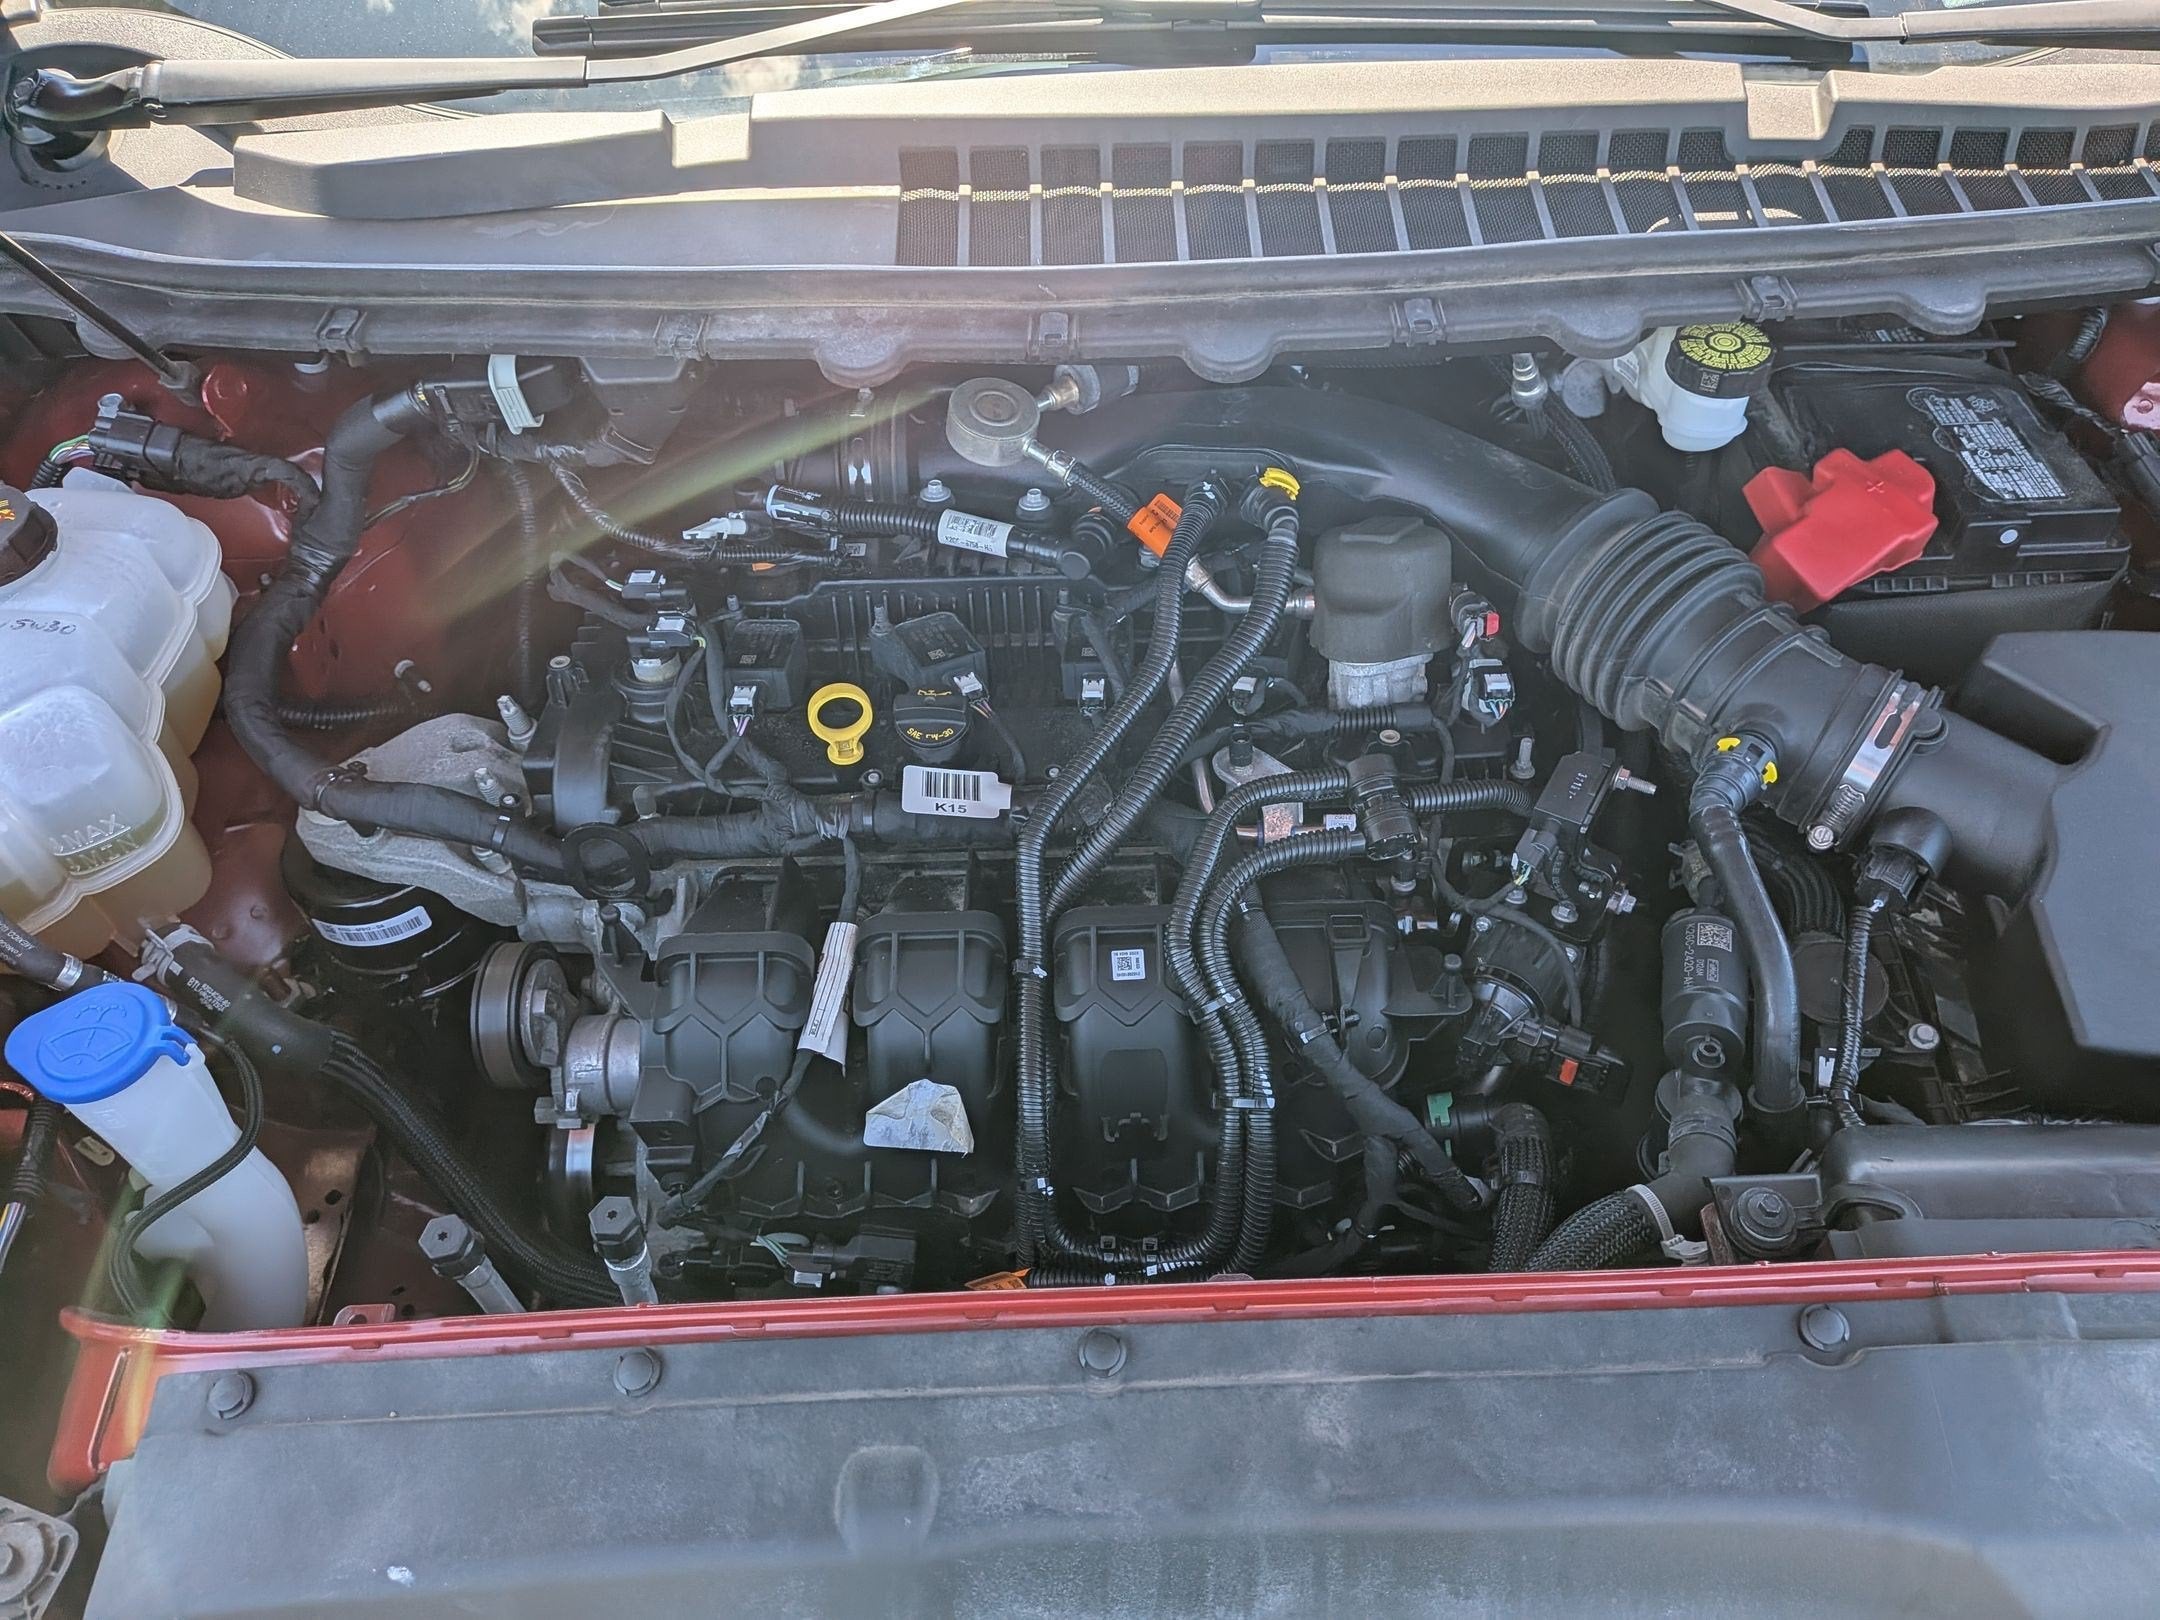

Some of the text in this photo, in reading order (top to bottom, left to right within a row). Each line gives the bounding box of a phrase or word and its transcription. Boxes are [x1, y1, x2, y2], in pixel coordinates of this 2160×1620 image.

[906, 727, 922, 740] SAE
[935, 802, 967, 814] K15
[61, 813, 125, 849] MAX
[186, 976, 203, 993] BTL
